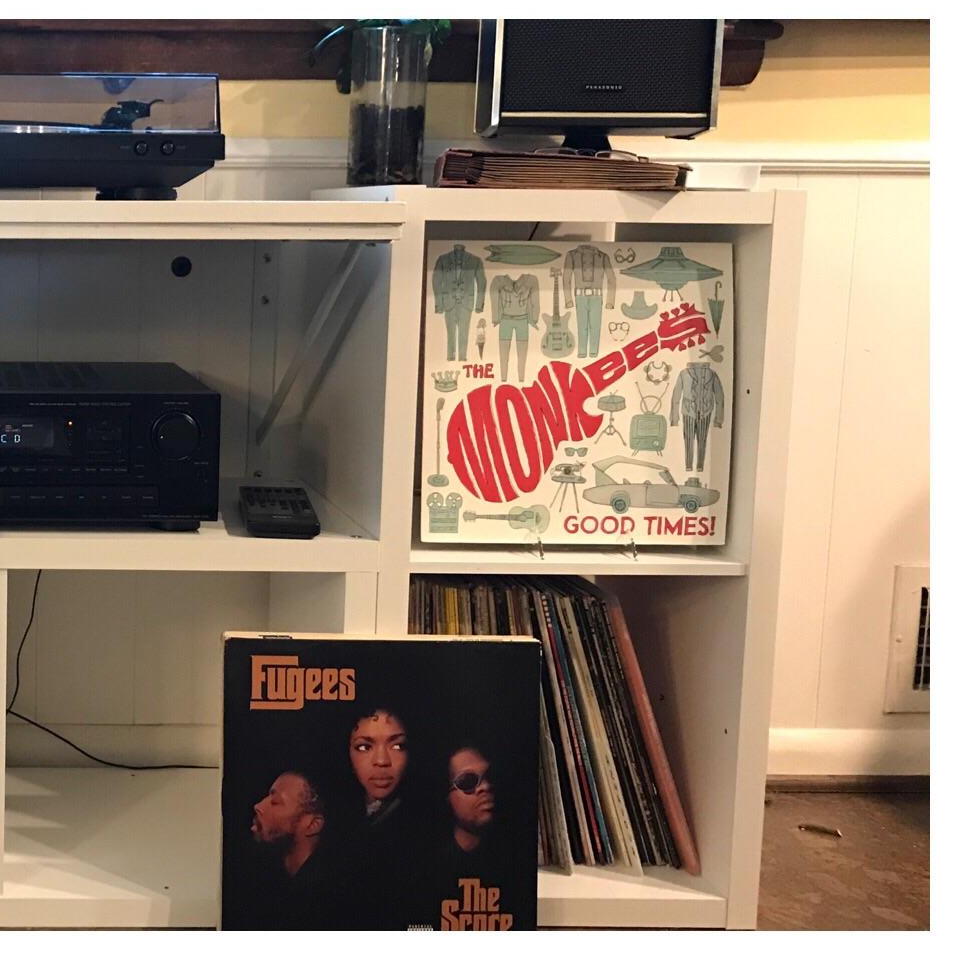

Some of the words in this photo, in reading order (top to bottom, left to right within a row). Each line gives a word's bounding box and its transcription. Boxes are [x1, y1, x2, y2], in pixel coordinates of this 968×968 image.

[462, 362, 495, 379] THE
[563, 515, 635, 534] GOOD
[644, 516, 716, 536] TIMES!
[250, 655, 356, 711] Fugees
[458, 878, 501, 912] The
